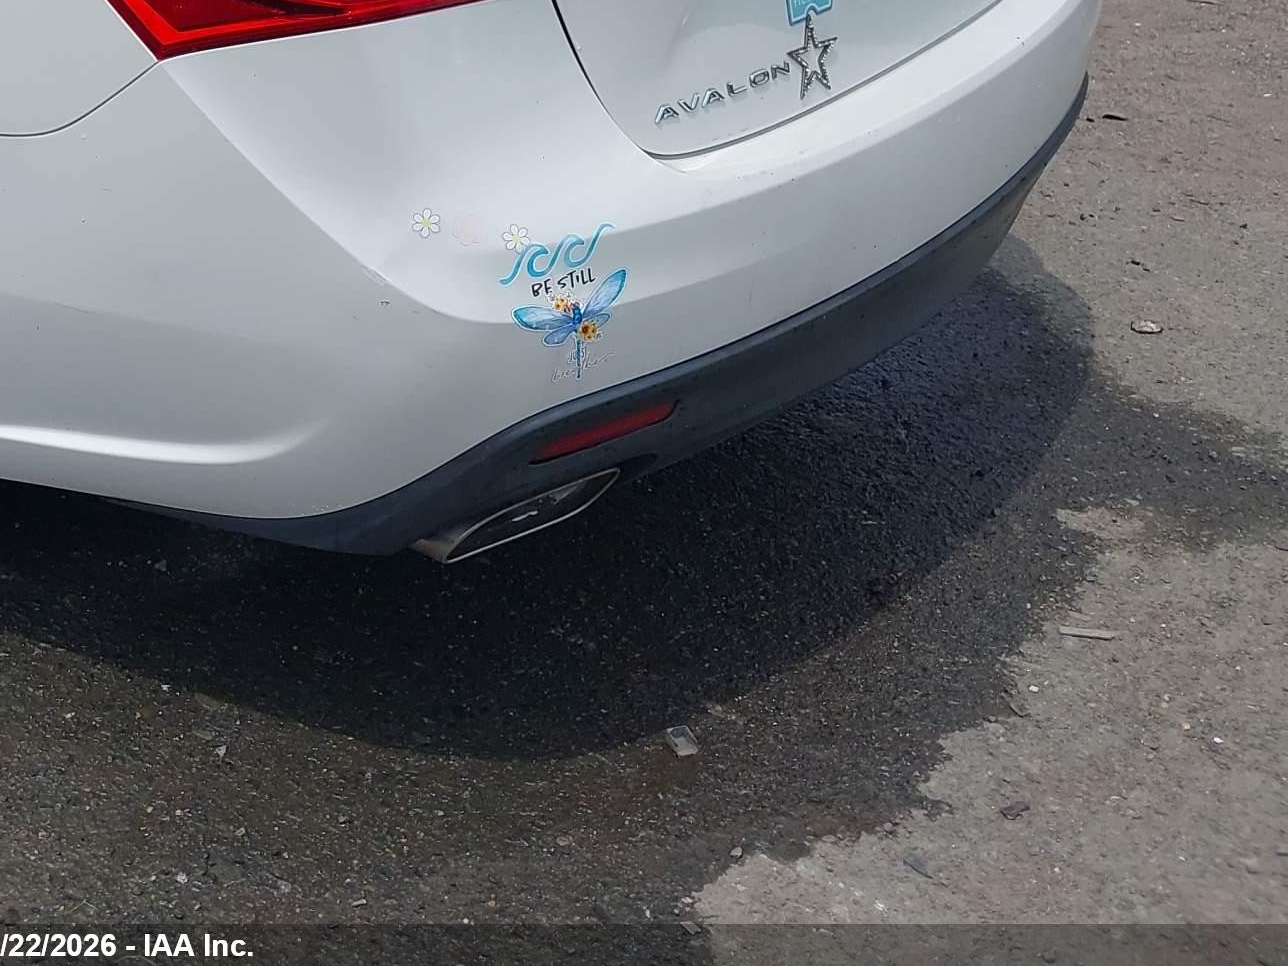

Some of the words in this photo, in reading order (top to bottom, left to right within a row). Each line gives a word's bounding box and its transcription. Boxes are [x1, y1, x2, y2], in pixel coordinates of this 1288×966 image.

[654, 60, 791, 125] AVALON
[531, 278, 553, 298] BE
[557, 267, 596, 289] STILL
